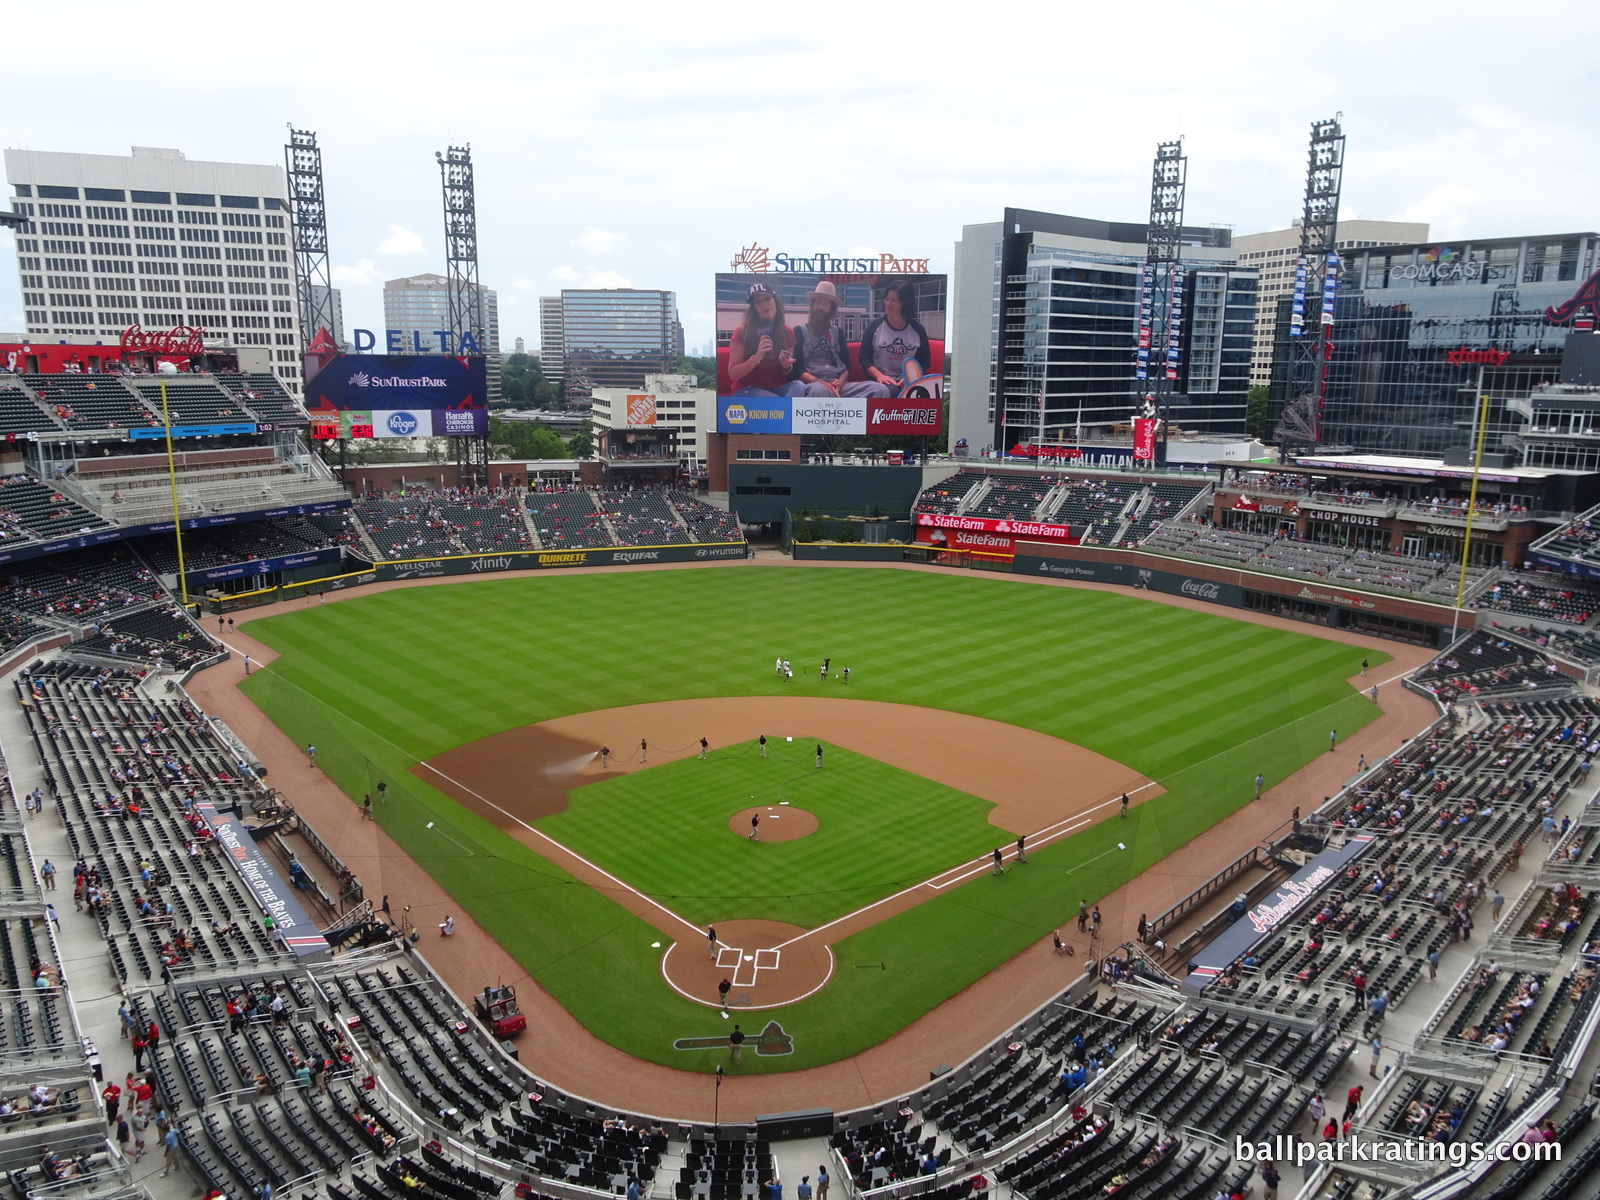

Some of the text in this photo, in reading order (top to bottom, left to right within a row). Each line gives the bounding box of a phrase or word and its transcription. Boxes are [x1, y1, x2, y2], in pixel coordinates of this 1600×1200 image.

[1390, 261, 1488, 280] COMCAST
[750, 283, 766, 294] ATL
[354, 328, 478, 351] DELTA
[1446, 347, 1510, 366] xfinity
[728, 410, 784, 420] NAPA KNOW HOW
[796, 409, 863, 418] NORTHSIDE
[390, 415, 416, 432] Kroger
[27, 432, 38, 441] 42
[1070, 454, 1096, 468] BALL
[1259, 504, 1284, 514] LIGHT
[1310, 510, 1379, 526] CHOP HOUSE
[538, 553, 587, 563] QUIKRETE
[613, 552, 659, 562] EQUIFAX
[394, 561, 442, 571] WELLSTAR
[471, 557, 512, 572] xfinity
[1050, 565, 1095, 576] Georgia Power
[1359, 600, 1375, 608] CHOP
[240, 860, 296, 929] HOME OF THE BRAVES
[1248, 866, 1334, 933] Atlanta Braves
